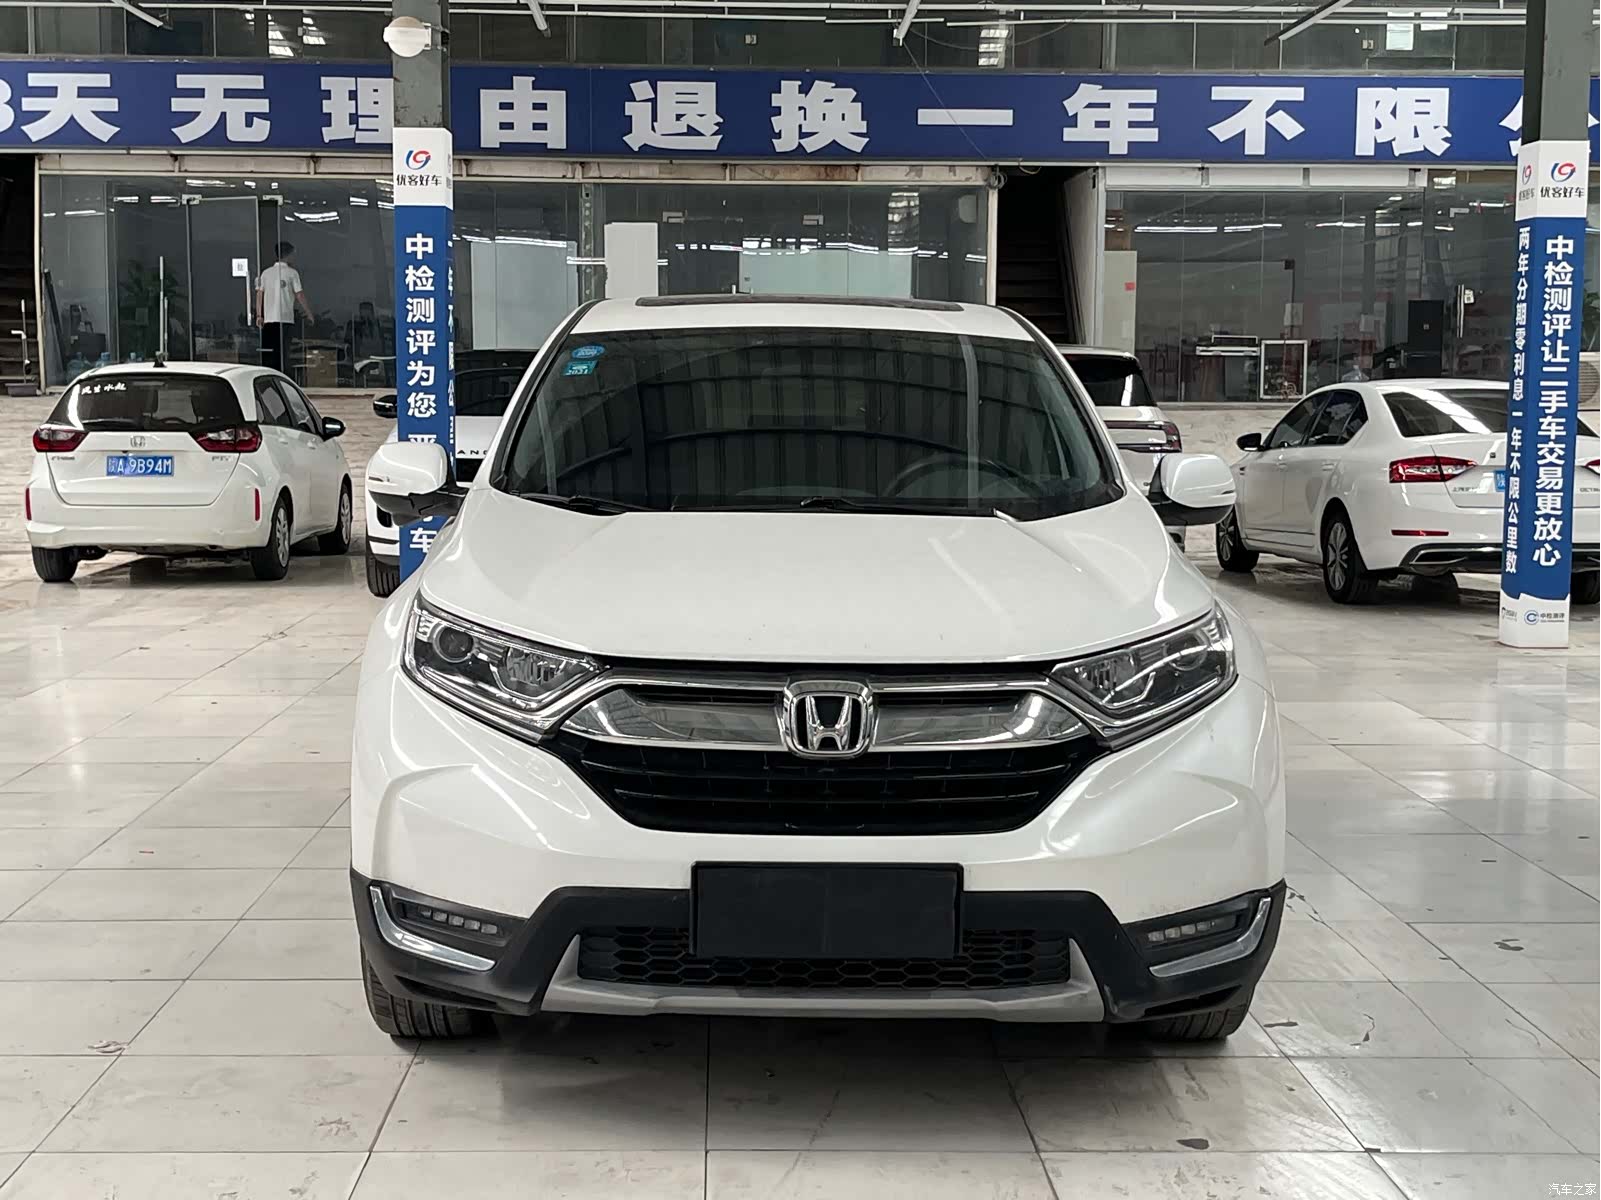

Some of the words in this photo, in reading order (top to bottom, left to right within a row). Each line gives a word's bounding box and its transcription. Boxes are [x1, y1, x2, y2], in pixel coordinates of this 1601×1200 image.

[396, 174, 442, 186] 优客好车
[1540, 186, 1585, 198] 优客好车
[1532, 235, 1574, 566] 中检测评让二手车交易更放心
